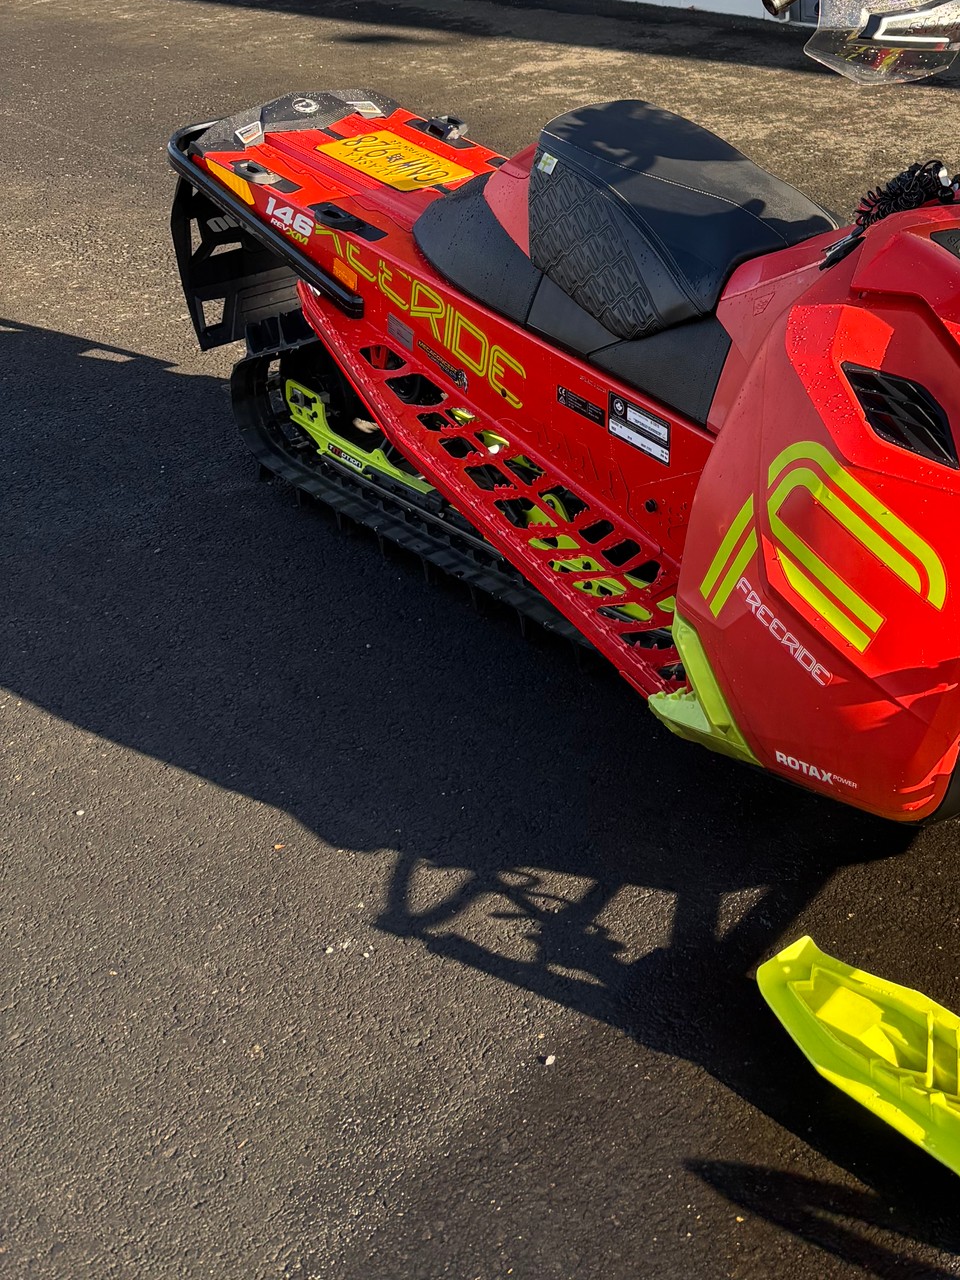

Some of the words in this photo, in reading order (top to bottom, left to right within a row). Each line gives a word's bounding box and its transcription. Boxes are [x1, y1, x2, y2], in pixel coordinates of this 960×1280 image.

[266, 197, 314, 237] 146
[736, 577, 831, 686] FREERIDE
[775, 750, 833, 785] ROTAX
[833, 774, 858, 789] POWER
